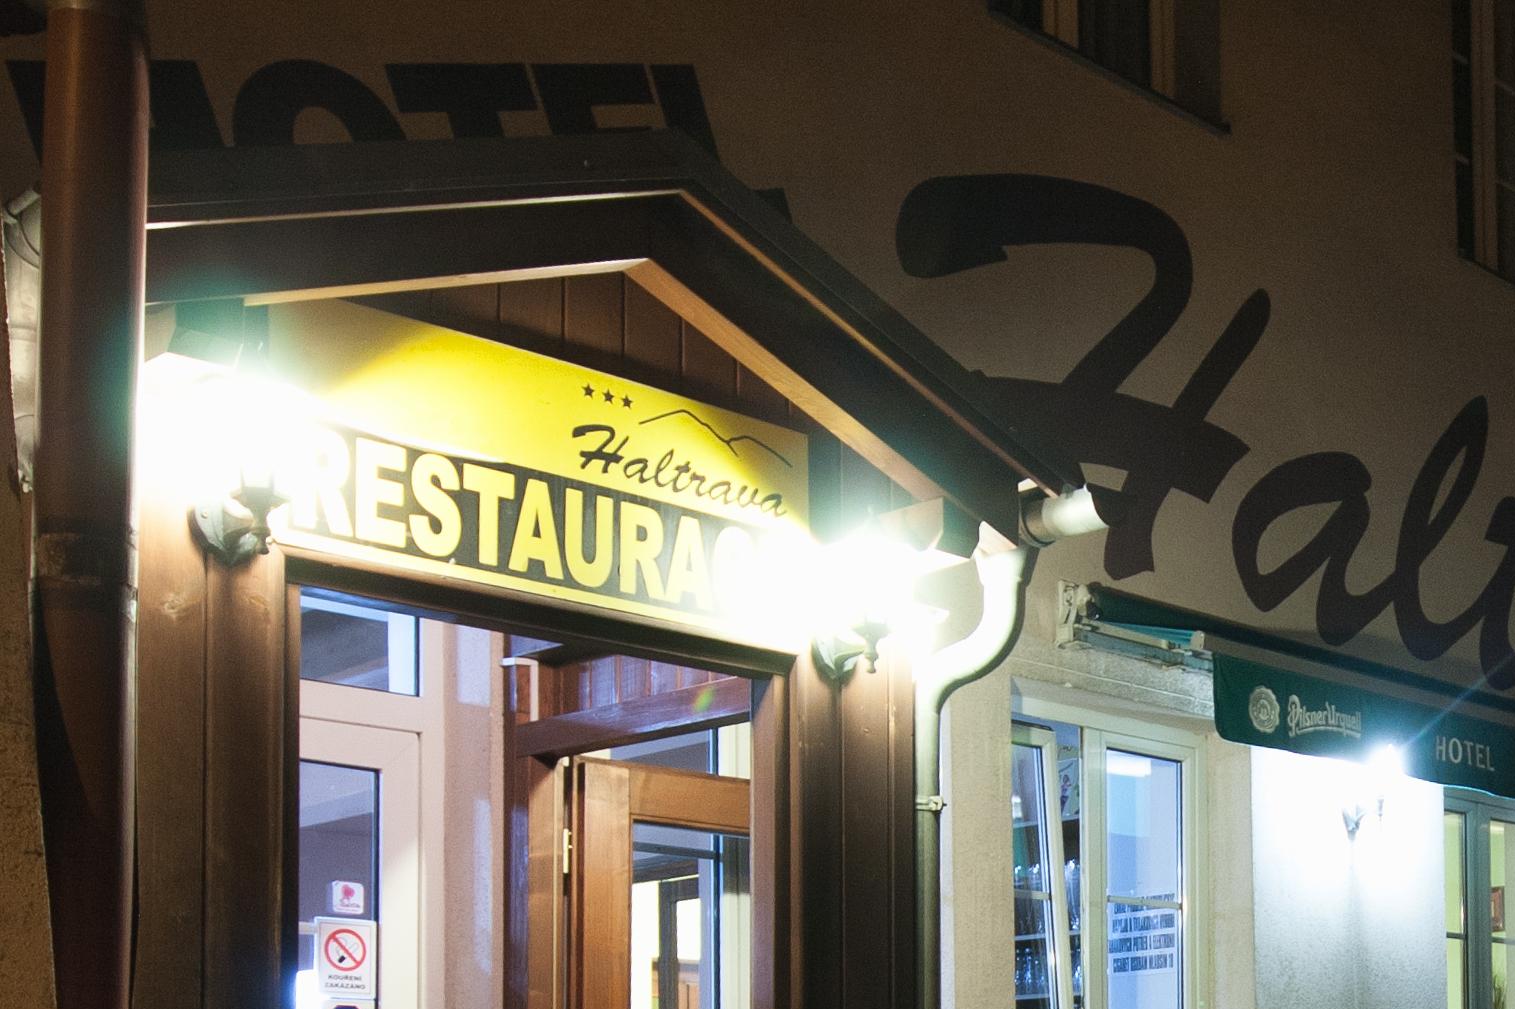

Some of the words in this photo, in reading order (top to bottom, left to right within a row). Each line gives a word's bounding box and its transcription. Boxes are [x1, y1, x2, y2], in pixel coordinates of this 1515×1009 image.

[572, 424, 788, 517] Haltrava
[1287, 694, 1328, 737] Pilsner
[1327, 701, 1362, 738] Urquell
[1435, 735, 1495, 772] HOTEL
